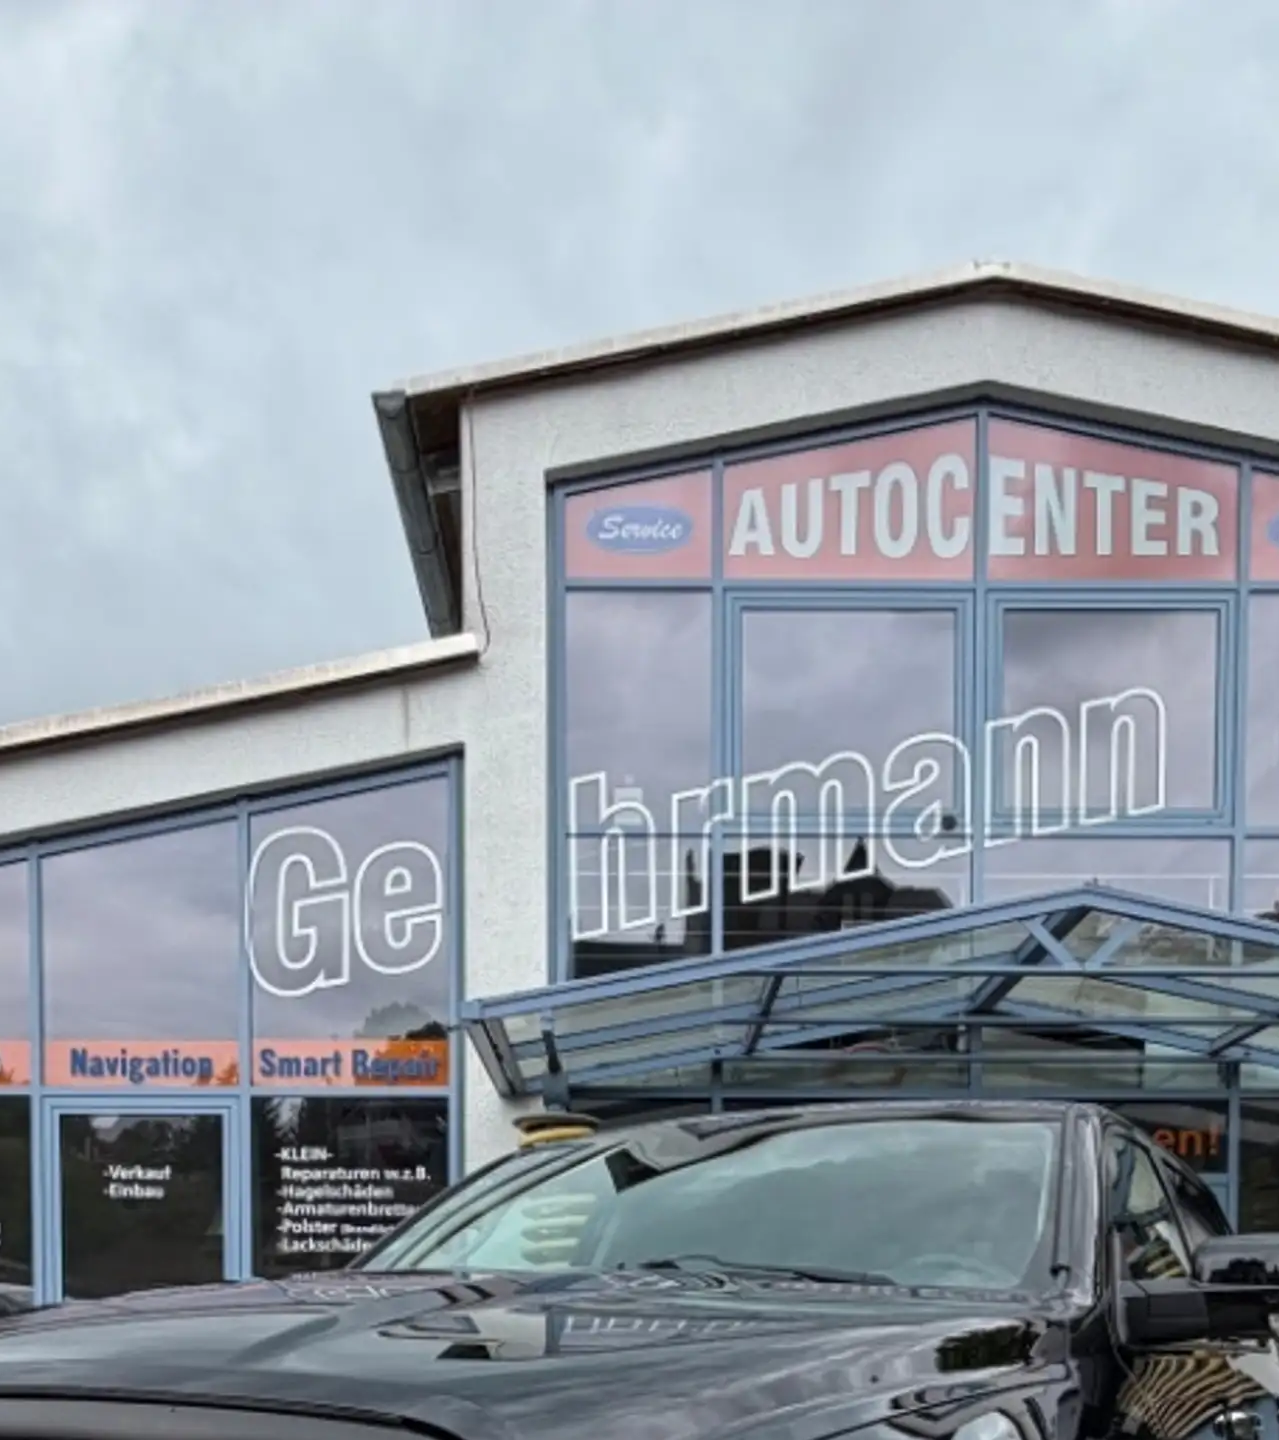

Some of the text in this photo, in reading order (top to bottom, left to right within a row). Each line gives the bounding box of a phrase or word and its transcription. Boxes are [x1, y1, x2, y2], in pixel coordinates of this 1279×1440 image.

[728, 453, 1220, 559] AUTOCENTER
[596, 513, 685, 542] Service
[70, 1047, 214, 1084] Navigation
[258, 1048, 440, 1083] Smart Repair
[280, 1166, 381, 1182] Reparaturen
